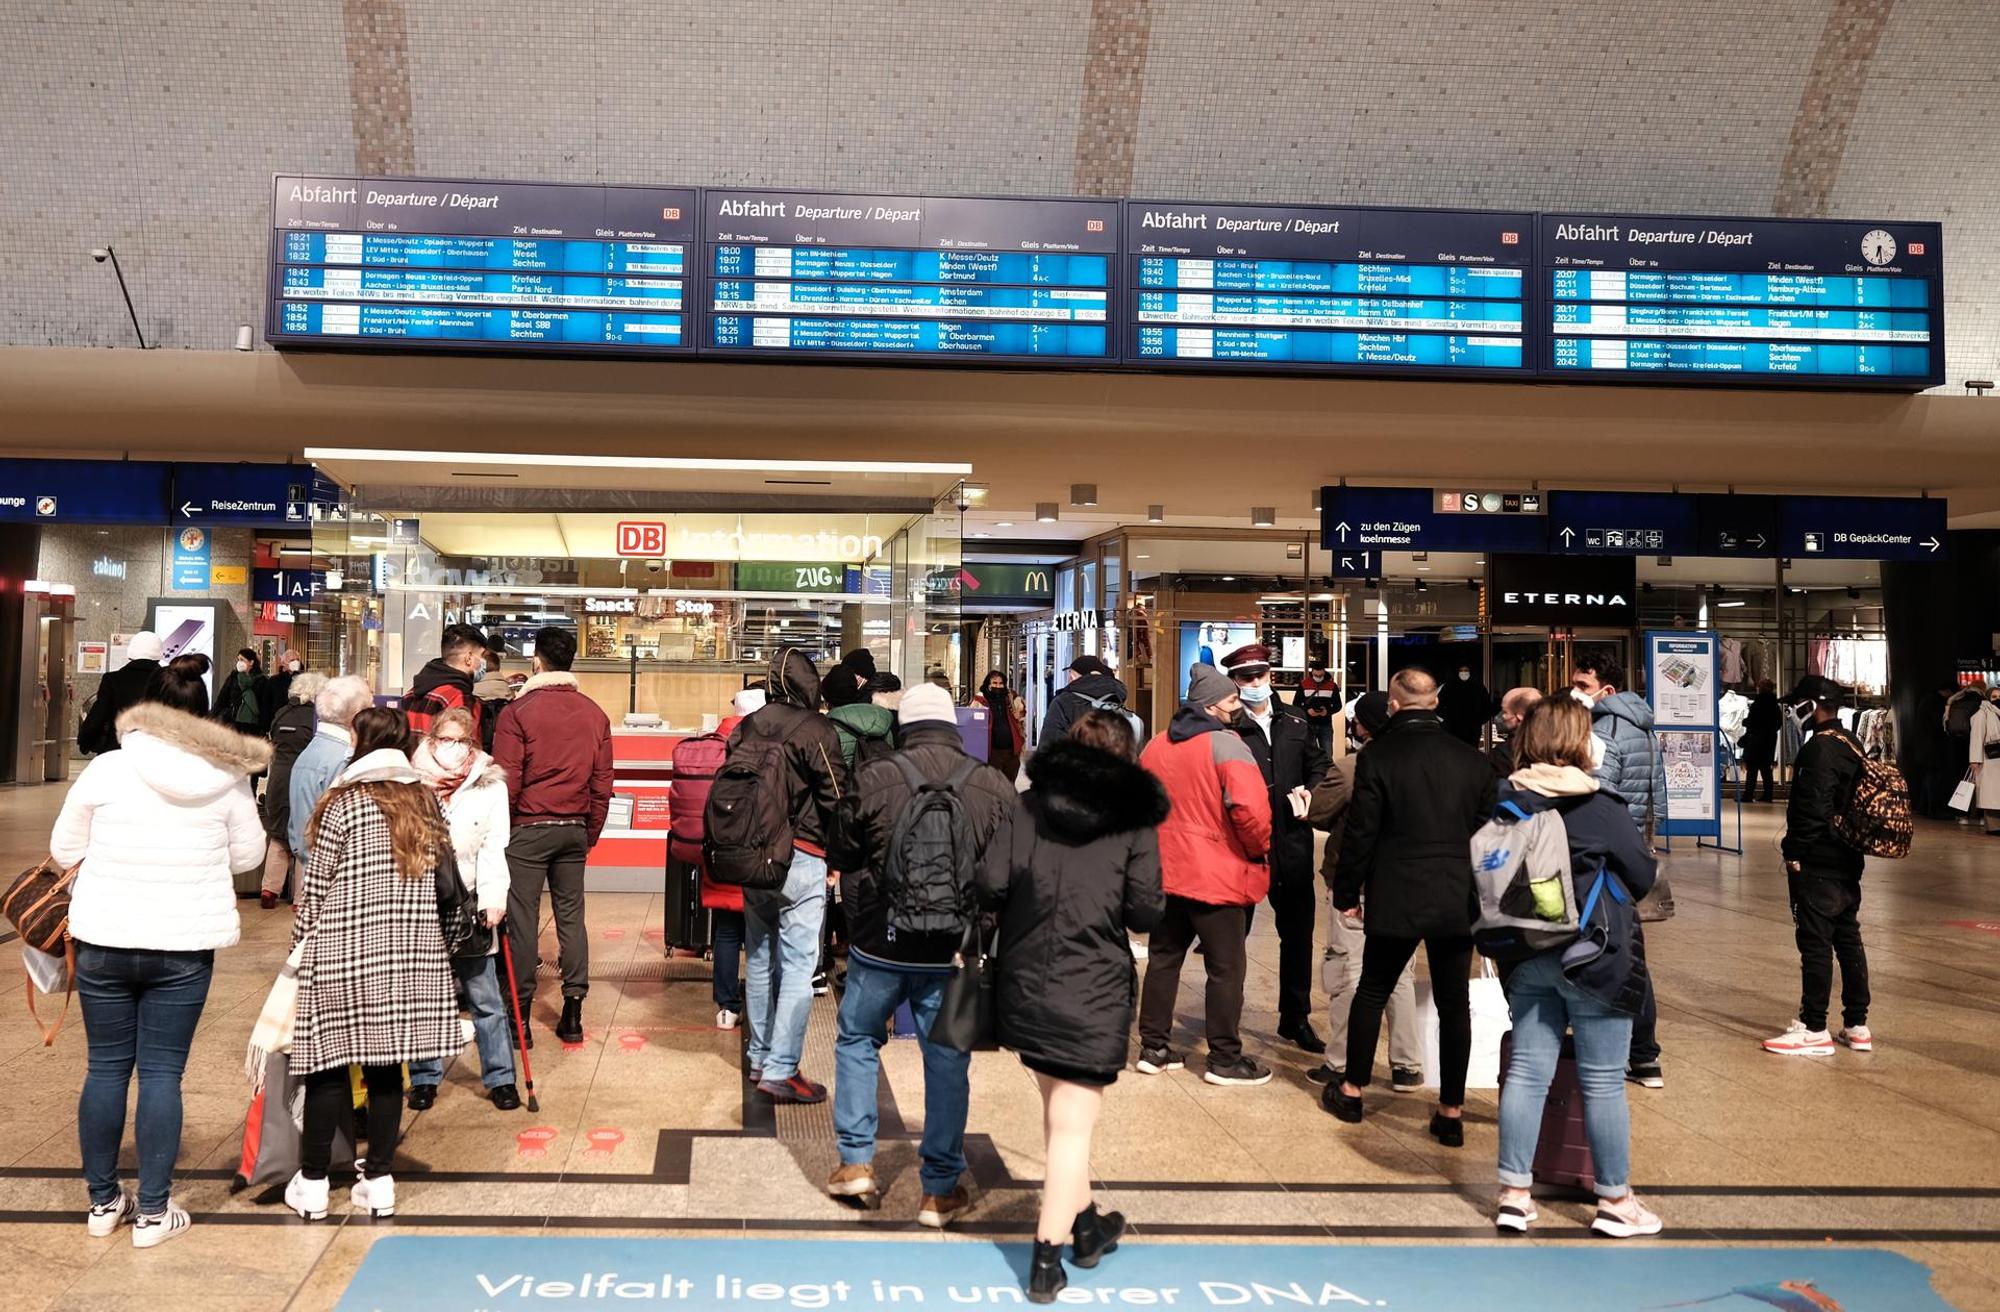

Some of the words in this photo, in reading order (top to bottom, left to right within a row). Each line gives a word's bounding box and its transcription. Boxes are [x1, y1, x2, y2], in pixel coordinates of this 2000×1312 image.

[290, 186, 357, 204] Abfahrt
[367, 191, 437, 207] Departure
[449, 193, 499, 210] Départ
[664, 209, 679, 219] DB
[719, 200, 785, 217] Abfahrt
[795, 205, 862, 221] Departure
[874, 207, 920, 224] Départ
[367, 220, 384, 229] Über
[1088, 221, 1102, 230] DB
[1142, 212, 1206, 229] Abfahrt
[1216, 217, 1282, 232] Departure
[1294, 220, 1339, 235] Départ
[513, 226, 527, 234] Ziel
[596, 229, 614, 237] Gleis
[796, 234, 813, 243] Über
[1503, 233, 1517, 243] DB
[1556, 224, 1619, 241] Abfahrt
[1628, 229, 1695, 244] Departure
[1707, 231, 1752, 246] Départ
[513, 241, 536, 249] Hagen
[1021, 241, 1039, 249] Gleis
[1909, 244, 1924, 254] DB
[1217, 245, 1234, 254] Über
[719, 256, 740, 264] 19:07
[948, 254, 999, 262] Messe/Deutz
[1629, 258, 1646, 266] Über
[512, 259, 545, 268] Sechtem
[1143, 268, 1163, 276] 19:40
[1358, 265, 1390, 273] Sechtem
[1845, 264, 1863, 272] Gleis
[940, 272, 975, 280] Dortmund
[1768, 276, 1793, 284] Minden
[288, 278, 308, 286] 18:43
[719, 282, 739, 290] 19:14
[511, 285, 531, 293] Paris
[939, 288, 983, 296] Amsterdam
[719, 291, 739, 299] 19:15
[1142, 293, 1162, 301] 19:48
[286, 304, 307, 312] 18:52
[1556, 305, 1576, 313] 20:17
[718, 317, 738, 325] 19:21
[718, 326, 738, 334] 19:25
[938, 323, 961, 331] Hagen
[511, 330, 543, 339] Sechtem
[950, 333, 995, 341] Oberbarmen
[717, 336, 738, 344] 19:31
[938, 342, 982, 350] Oberhausen
[1769, 345, 1811, 353] Oberhausen
[1556, 349, 1577, 357] 20:32
[1366, 354, 1416, 362] Messe/Deutz
[1557, 358, 1577, 366] 20:42
[1769, 354, 1801, 362] Sechtem
[211, 500, 276, 511] ReiseZentrum
[1464, 494, 1478, 511] S
[1360, 524, 1372, 532] zu
[1374, 522, 1390, 532] den
[1392, 522, 1421, 533] Zügen
[622, 525, 662, 552] DB
[681, 526, 882, 558] Information
[1360, 534, 1411, 544] koelnmesse
[1834, 533, 1847, 543] DB
[1849, 533, 1912, 545] GepäckCenter
[1361, 551, 1369, 569] 1
[795, 566, 832, 588] ZUG
[273, 571, 283, 596] 1
[291, 582, 321, 597] A-F
[1504, 592, 1627, 606] ETERNA
[585, 597, 635, 613] Snack
[675, 599, 714, 615] Stop
[1053, 608, 1098, 631] ETERNA
[475, 1273, 695, 1300] Vielfalt
[715, 1274, 853, 1308] liegt
[871, 1280, 926, 1303] in
[946, 1285, 1181, 1308] unerer
[1198, 1282, 1387, 1307] DNA.
